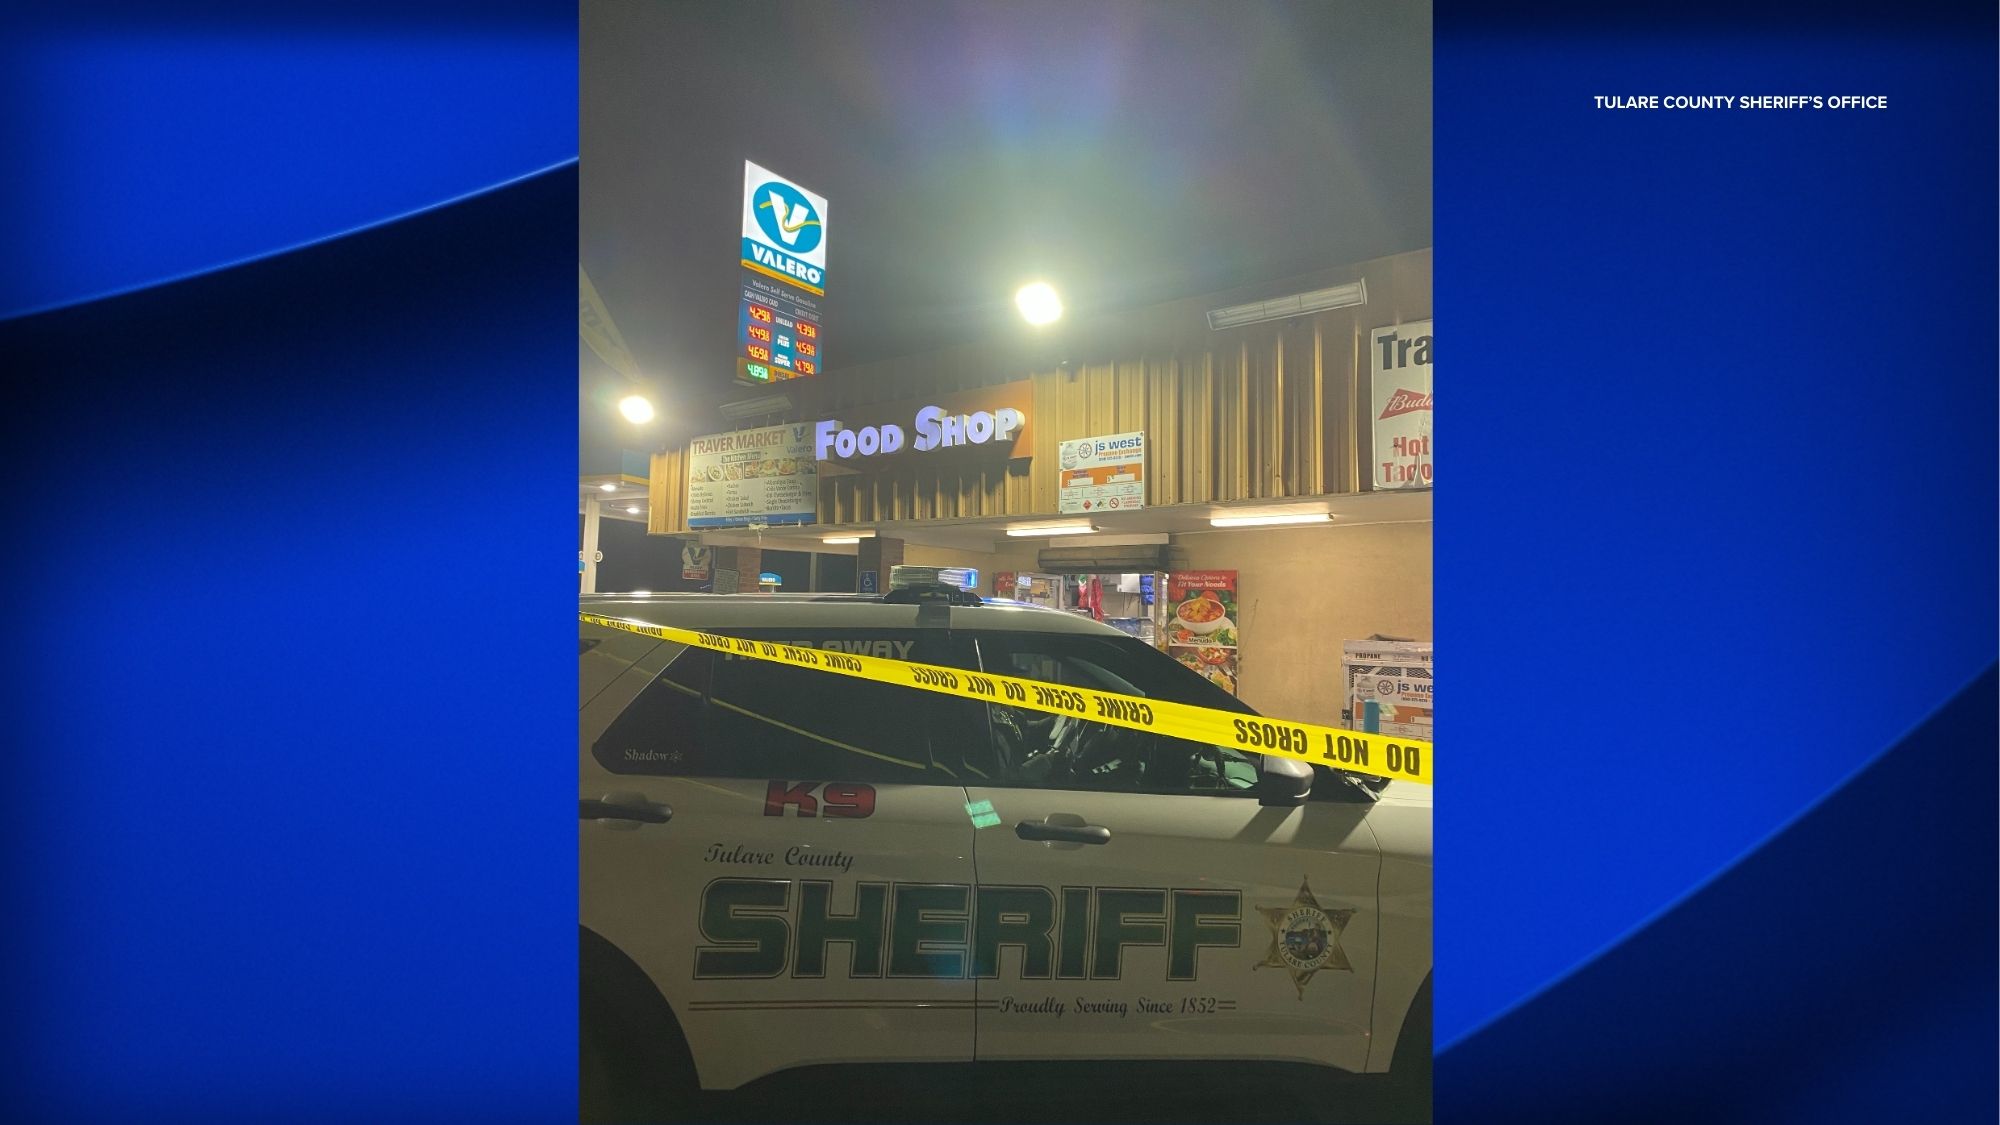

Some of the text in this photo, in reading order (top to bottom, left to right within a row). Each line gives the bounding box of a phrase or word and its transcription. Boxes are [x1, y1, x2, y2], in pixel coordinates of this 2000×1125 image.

[751, 243, 821, 285] VALERO
[752, 280, 770, 291] Valero
[770, 286, 781, 294] Self
[781, 290, 795, 301] Serve
[777, 338, 790, 348] PLUS
[1377, 331, 1433, 371] Tra
[692, 430, 786, 454] TRAVER MARKET
[1095, 436, 1142, 456] js west
[1393, 435, 1429, 457] Hot
[825, 654, 863, 673] CRIME
[1355, 652, 1381, 660] PROPANE
[911, 666, 1155, 726] CRIME SCENE DO NOT CROSS
[1397, 680, 1410, 694] js
[624, 748, 668, 761] Shadow
[1233, 718, 1420, 776] DO NOT CROSS
[763, 779, 877, 819] K9
[704, 842, 855, 873] Tulare County
[1287, 908, 1327, 922] SHERIFF
[692, 876, 1243, 982] SHERIFF
[999, 995, 1217, 1017] Proudly Serving Since 1852
